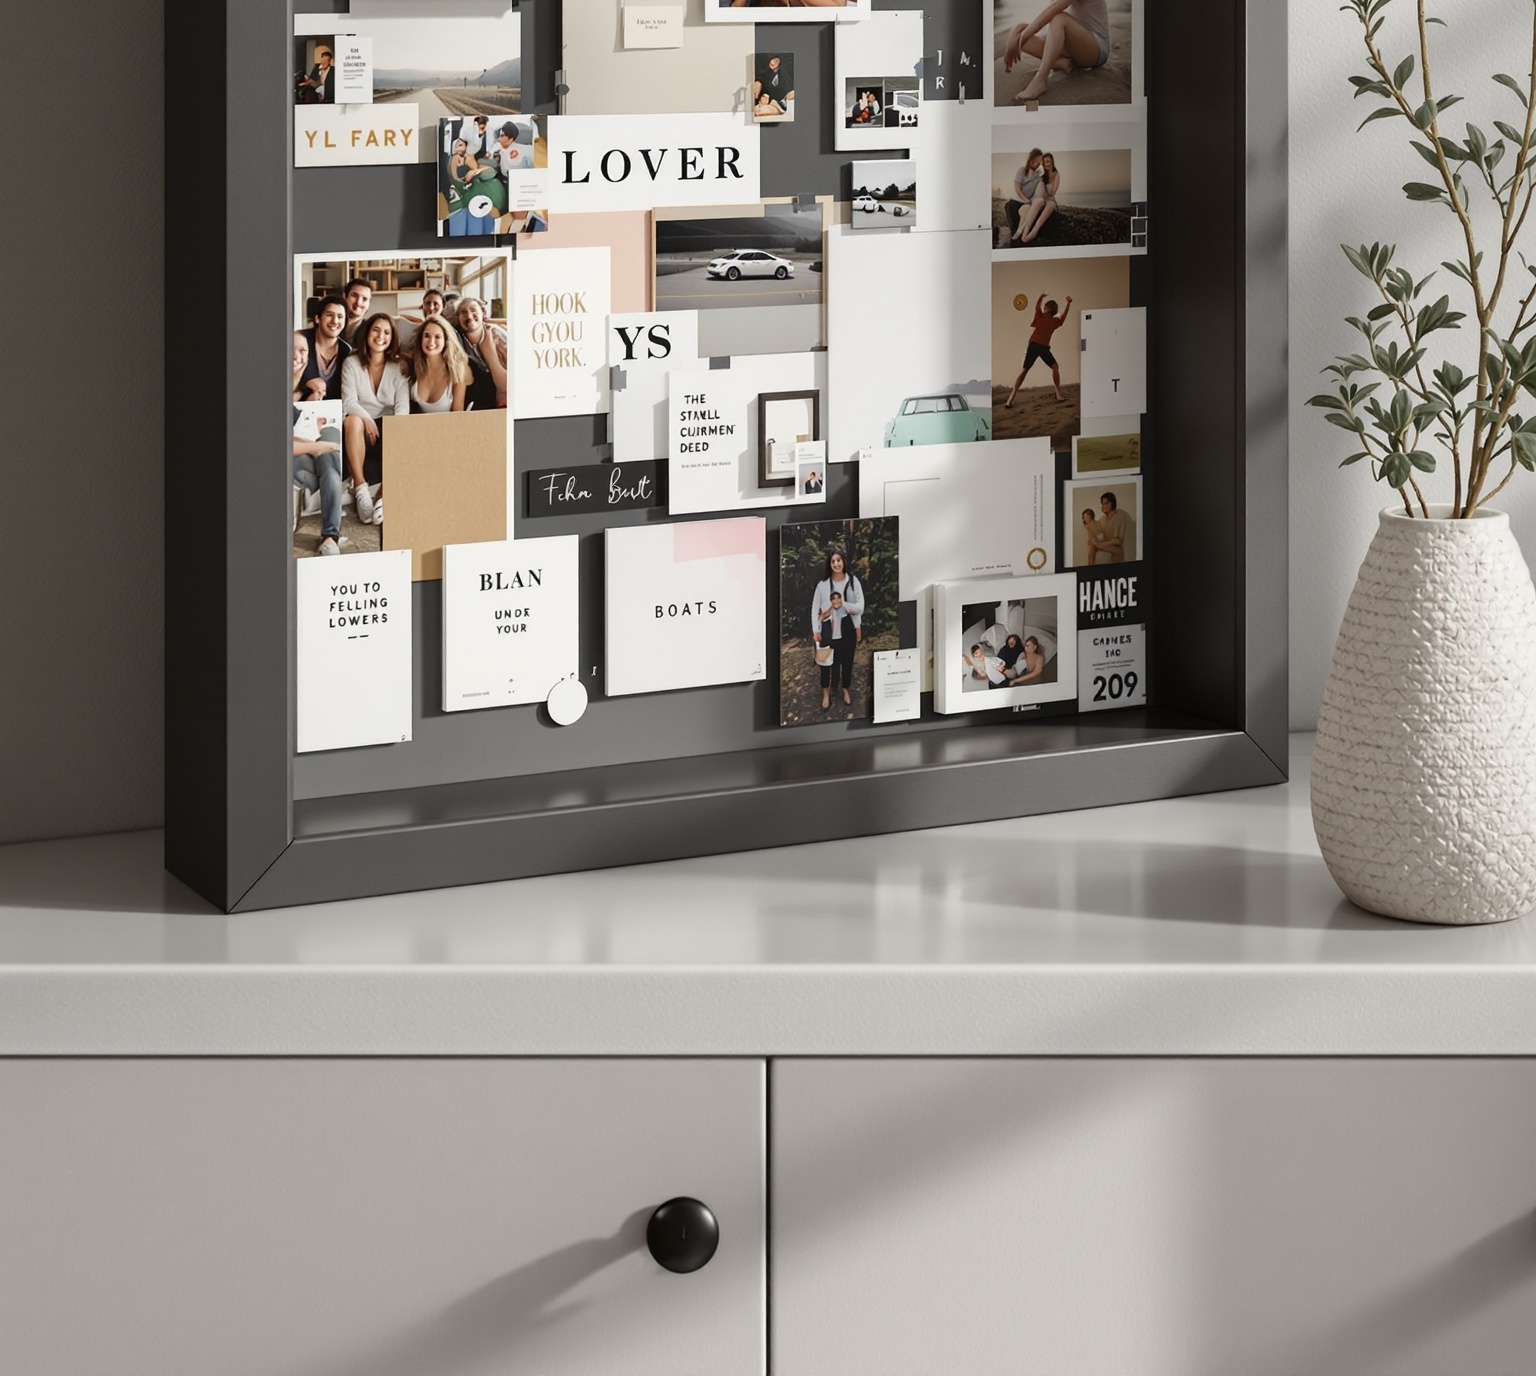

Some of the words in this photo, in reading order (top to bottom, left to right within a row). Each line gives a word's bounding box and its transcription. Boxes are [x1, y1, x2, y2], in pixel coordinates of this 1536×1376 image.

[304, 130, 337, 148] YL
[351, 128, 413, 147] FARY
[561, 146, 744, 184] LOVER
[531, 291, 588, 316] HOOK
[531, 320, 583, 344] GYOU
[613, 324, 672, 361] YS
[533, 347, 587, 370] YORK.
[684, 393, 706, 405] THE
[680, 441, 709, 454] DEED
[330, 584, 357, 596] YOU
[363, 581, 381, 593] TO
[479, 568, 543, 592] BLAN
[329, 597, 388, 612] FELLING
[1079, 576, 1138, 613] HANCE
[655, 600, 717, 619] BOATS
[329, 613, 388, 628] LOWERS
[497, 624, 527, 634] YOUR
[1093, 671, 1138, 702] 209
